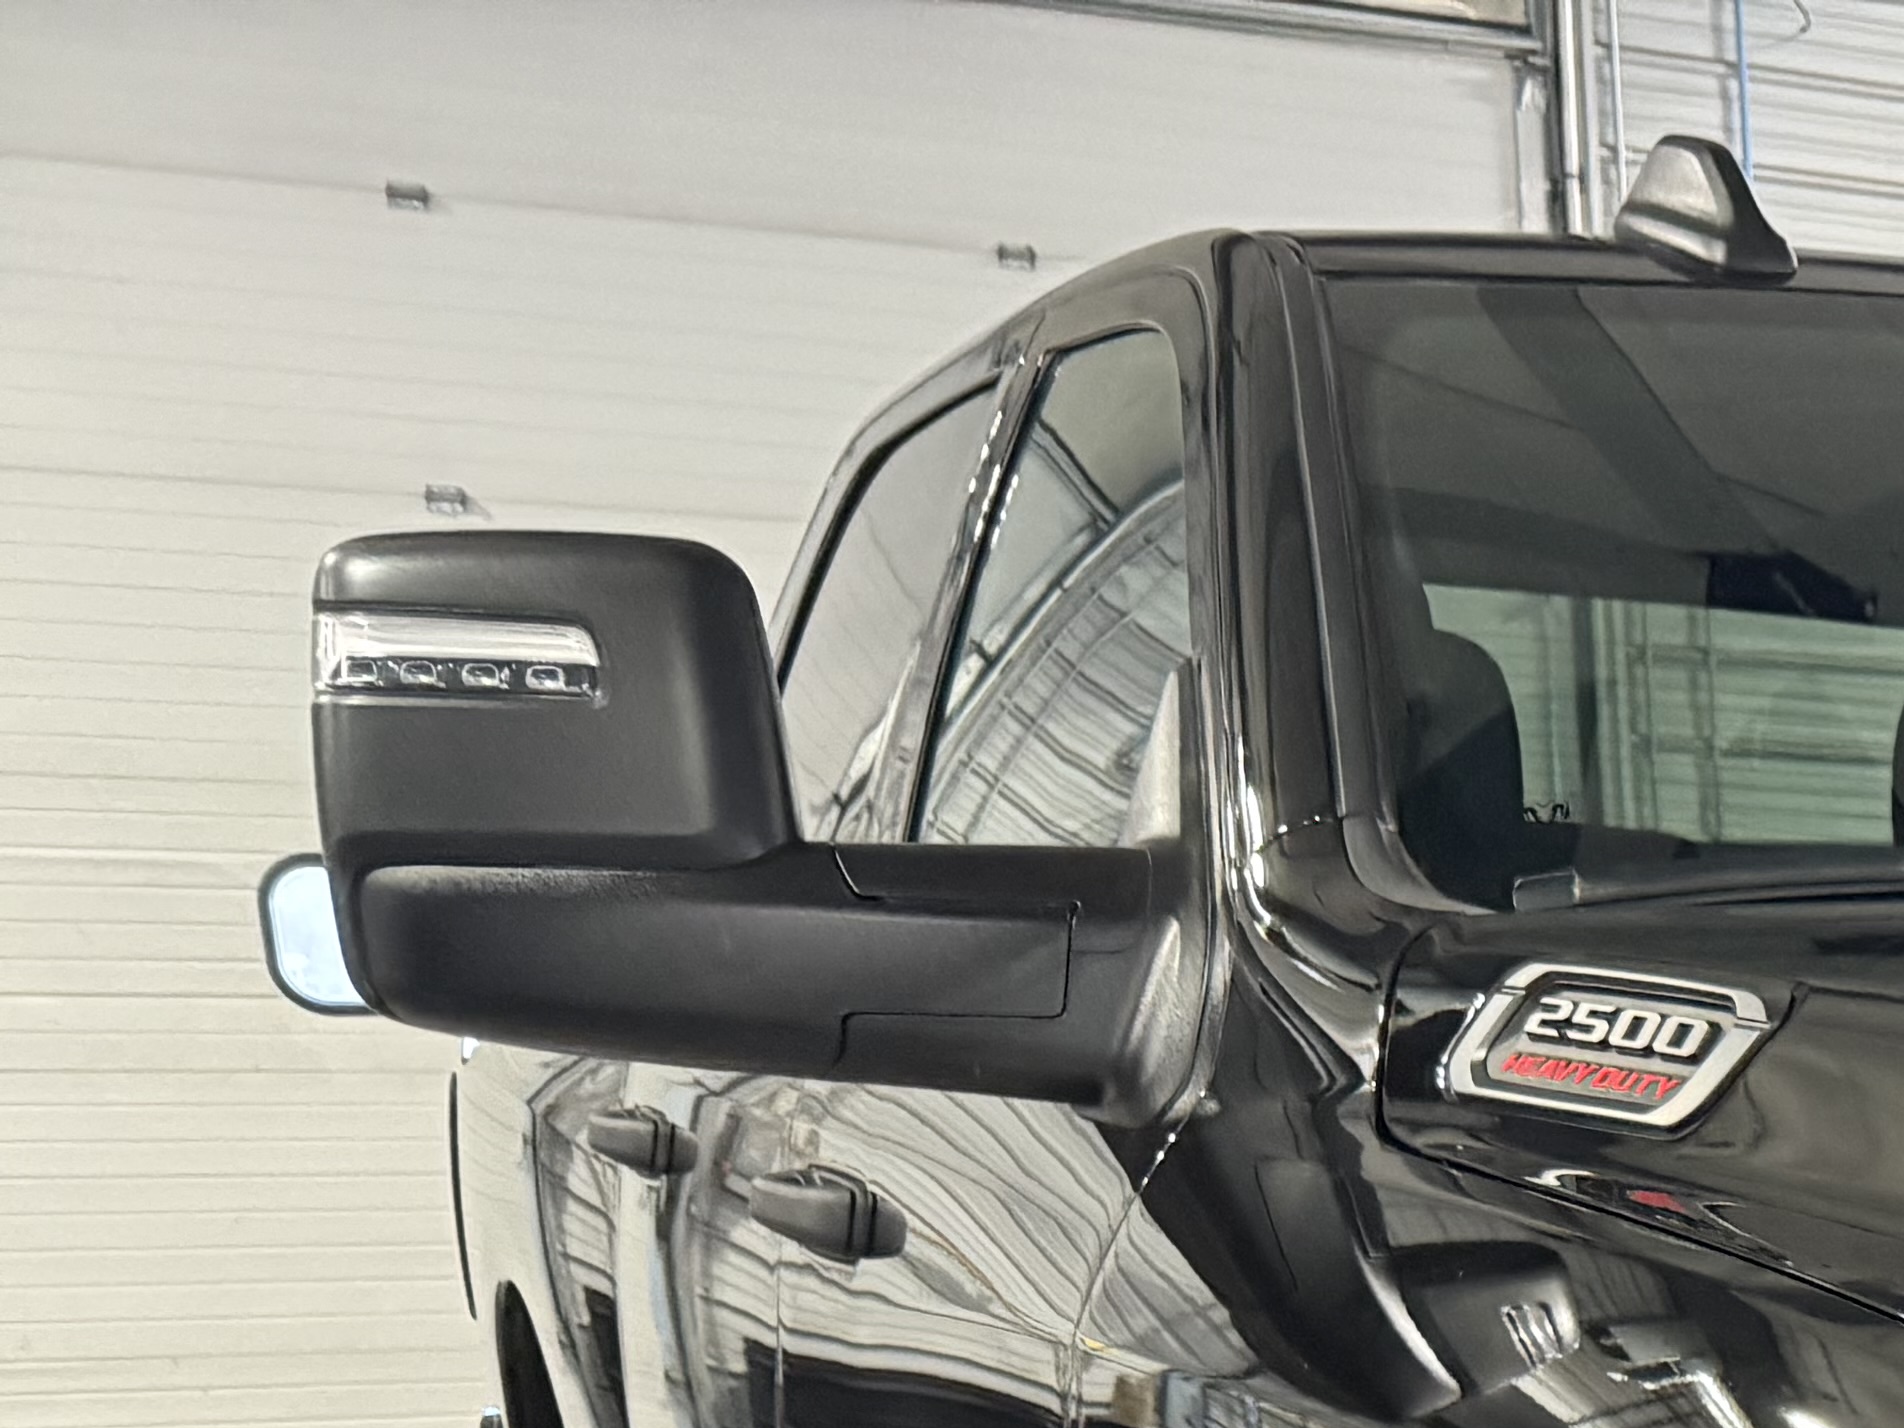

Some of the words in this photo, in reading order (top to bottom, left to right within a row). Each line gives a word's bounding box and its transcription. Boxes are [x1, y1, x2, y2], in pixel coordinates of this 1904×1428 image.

[1523, 997, 1710, 1058] 2500
[1502, 1053, 1594, 1084] HEAVY
[1592, 1066, 1681, 1100] DUTY
